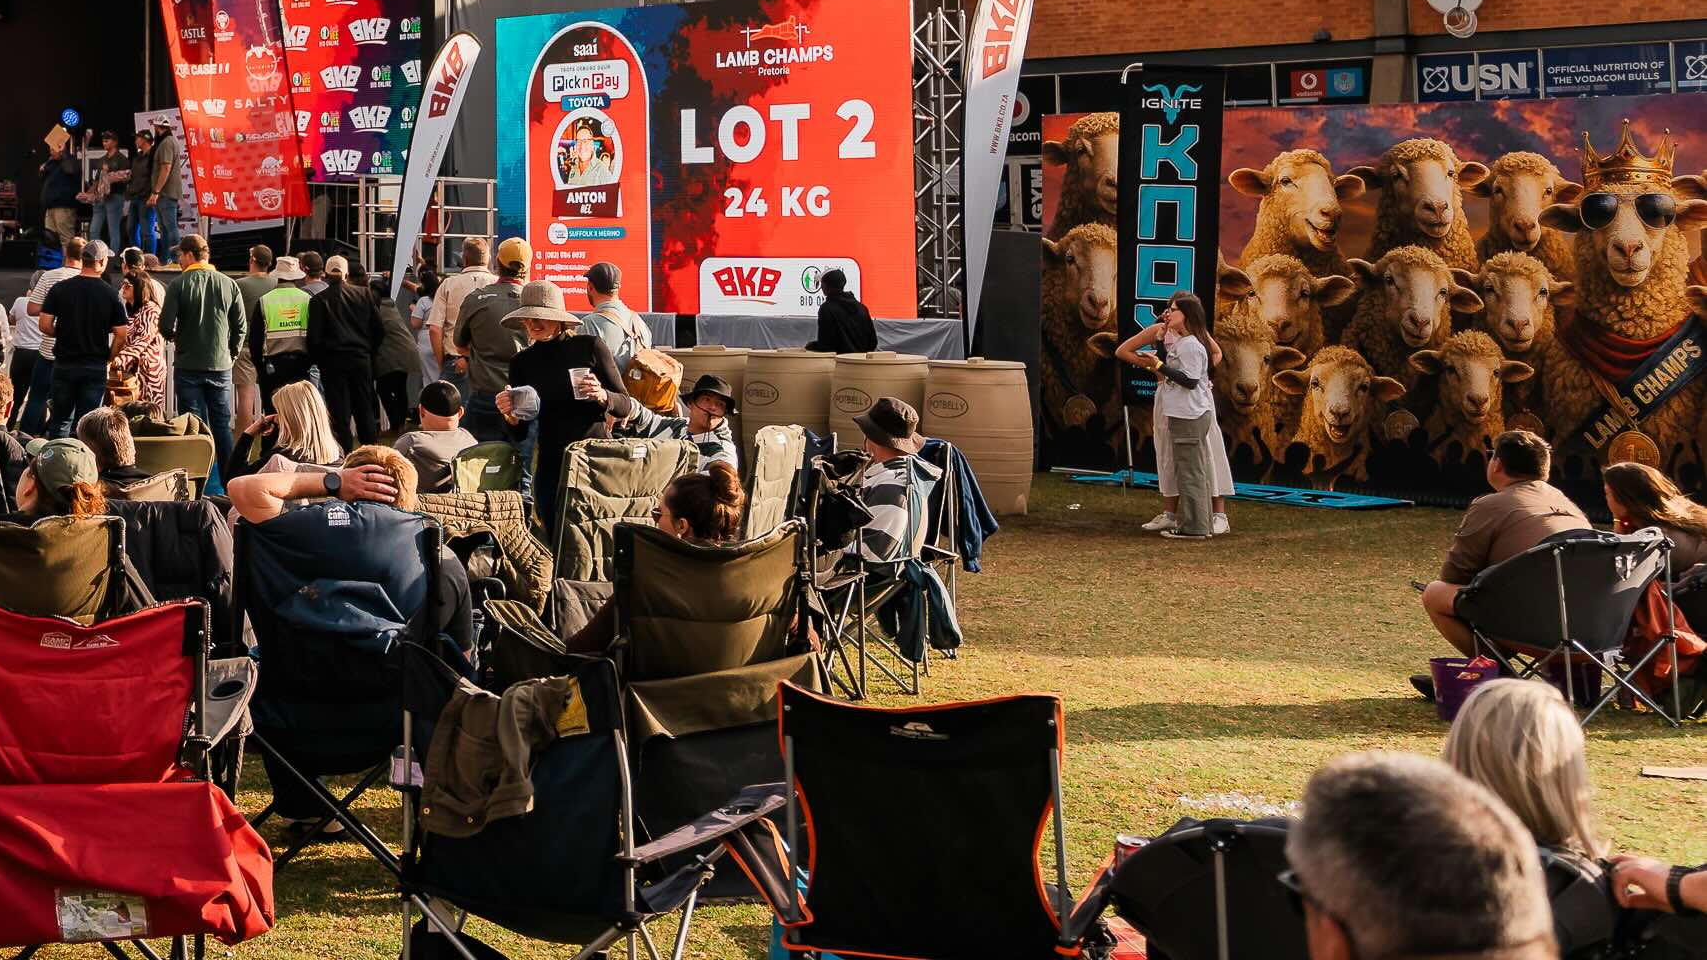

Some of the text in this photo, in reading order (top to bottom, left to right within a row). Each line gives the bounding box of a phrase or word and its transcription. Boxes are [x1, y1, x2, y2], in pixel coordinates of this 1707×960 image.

[181, 27, 206, 39] CASTLE
[348, 18, 390, 41] BKB
[573, 38, 598, 56] saai
[716, 45, 834, 68] LAMB CHAMPS
[320, 65, 361, 89] BKB
[758, 66, 790, 76] Pretoria
[1451, 61, 1527, 92] USN
[1547, 61, 1665, 74] OFFICIAL NUTRITION OF
[428, 42, 464, 118] BKB
[553, 73, 619, 92] Pick n Pay
[1553, 71, 1660, 85] THE VODACOM BULLS
[234, 95, 289, 109] SALTY
[568, 97, 605, 108] TOYOTA
[1141, 98, 1202, 109] IGNITE
[349, 106, 392, 128] BKB
[680, 99, 876, 164] LOT 2
[1009, 131, 1041, 142] acom
[320, 149, 362, 172] BKB
[566, 191, 606, 204] ANTON
[723, 186, 831, 218] 24 KG
[1030, 169, 1042, 220] GYM
[1134, 124, 1200, 352] KNO
[712, 266, 782, 297] BKB
[800, 296, 813, 306] BID
[1583, 338, 1702, 449] LAMB CHAMPS
[327, 511, 350, 520] camp
